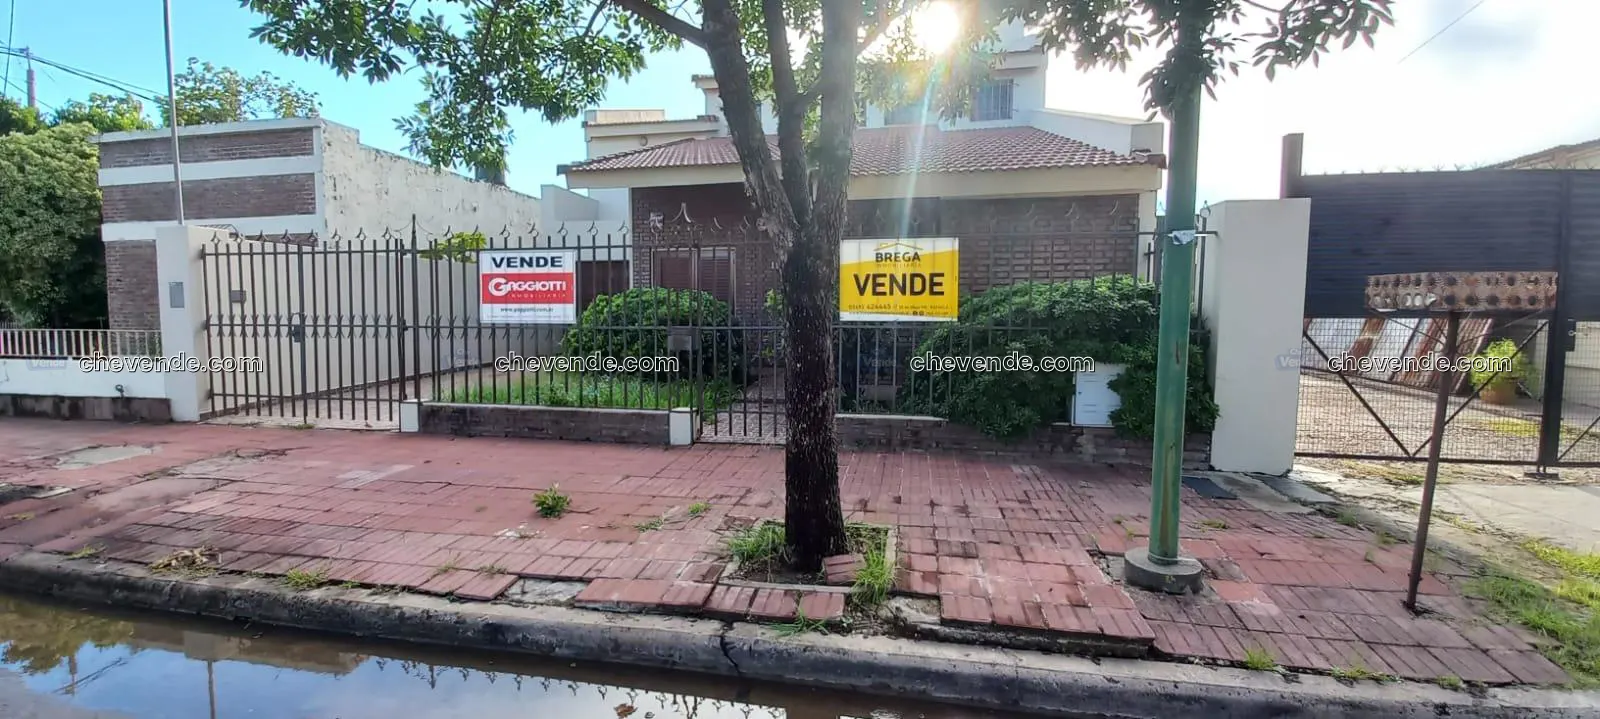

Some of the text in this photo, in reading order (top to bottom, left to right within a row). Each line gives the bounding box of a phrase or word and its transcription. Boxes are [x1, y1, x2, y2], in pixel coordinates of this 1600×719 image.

[491, 256, 563, 268] VENDE
[875, 251, 921, 263] BREGA
[488, 277, 567, 297] GAGGIOTTI
[853, 272, 945, 297] VENDE
